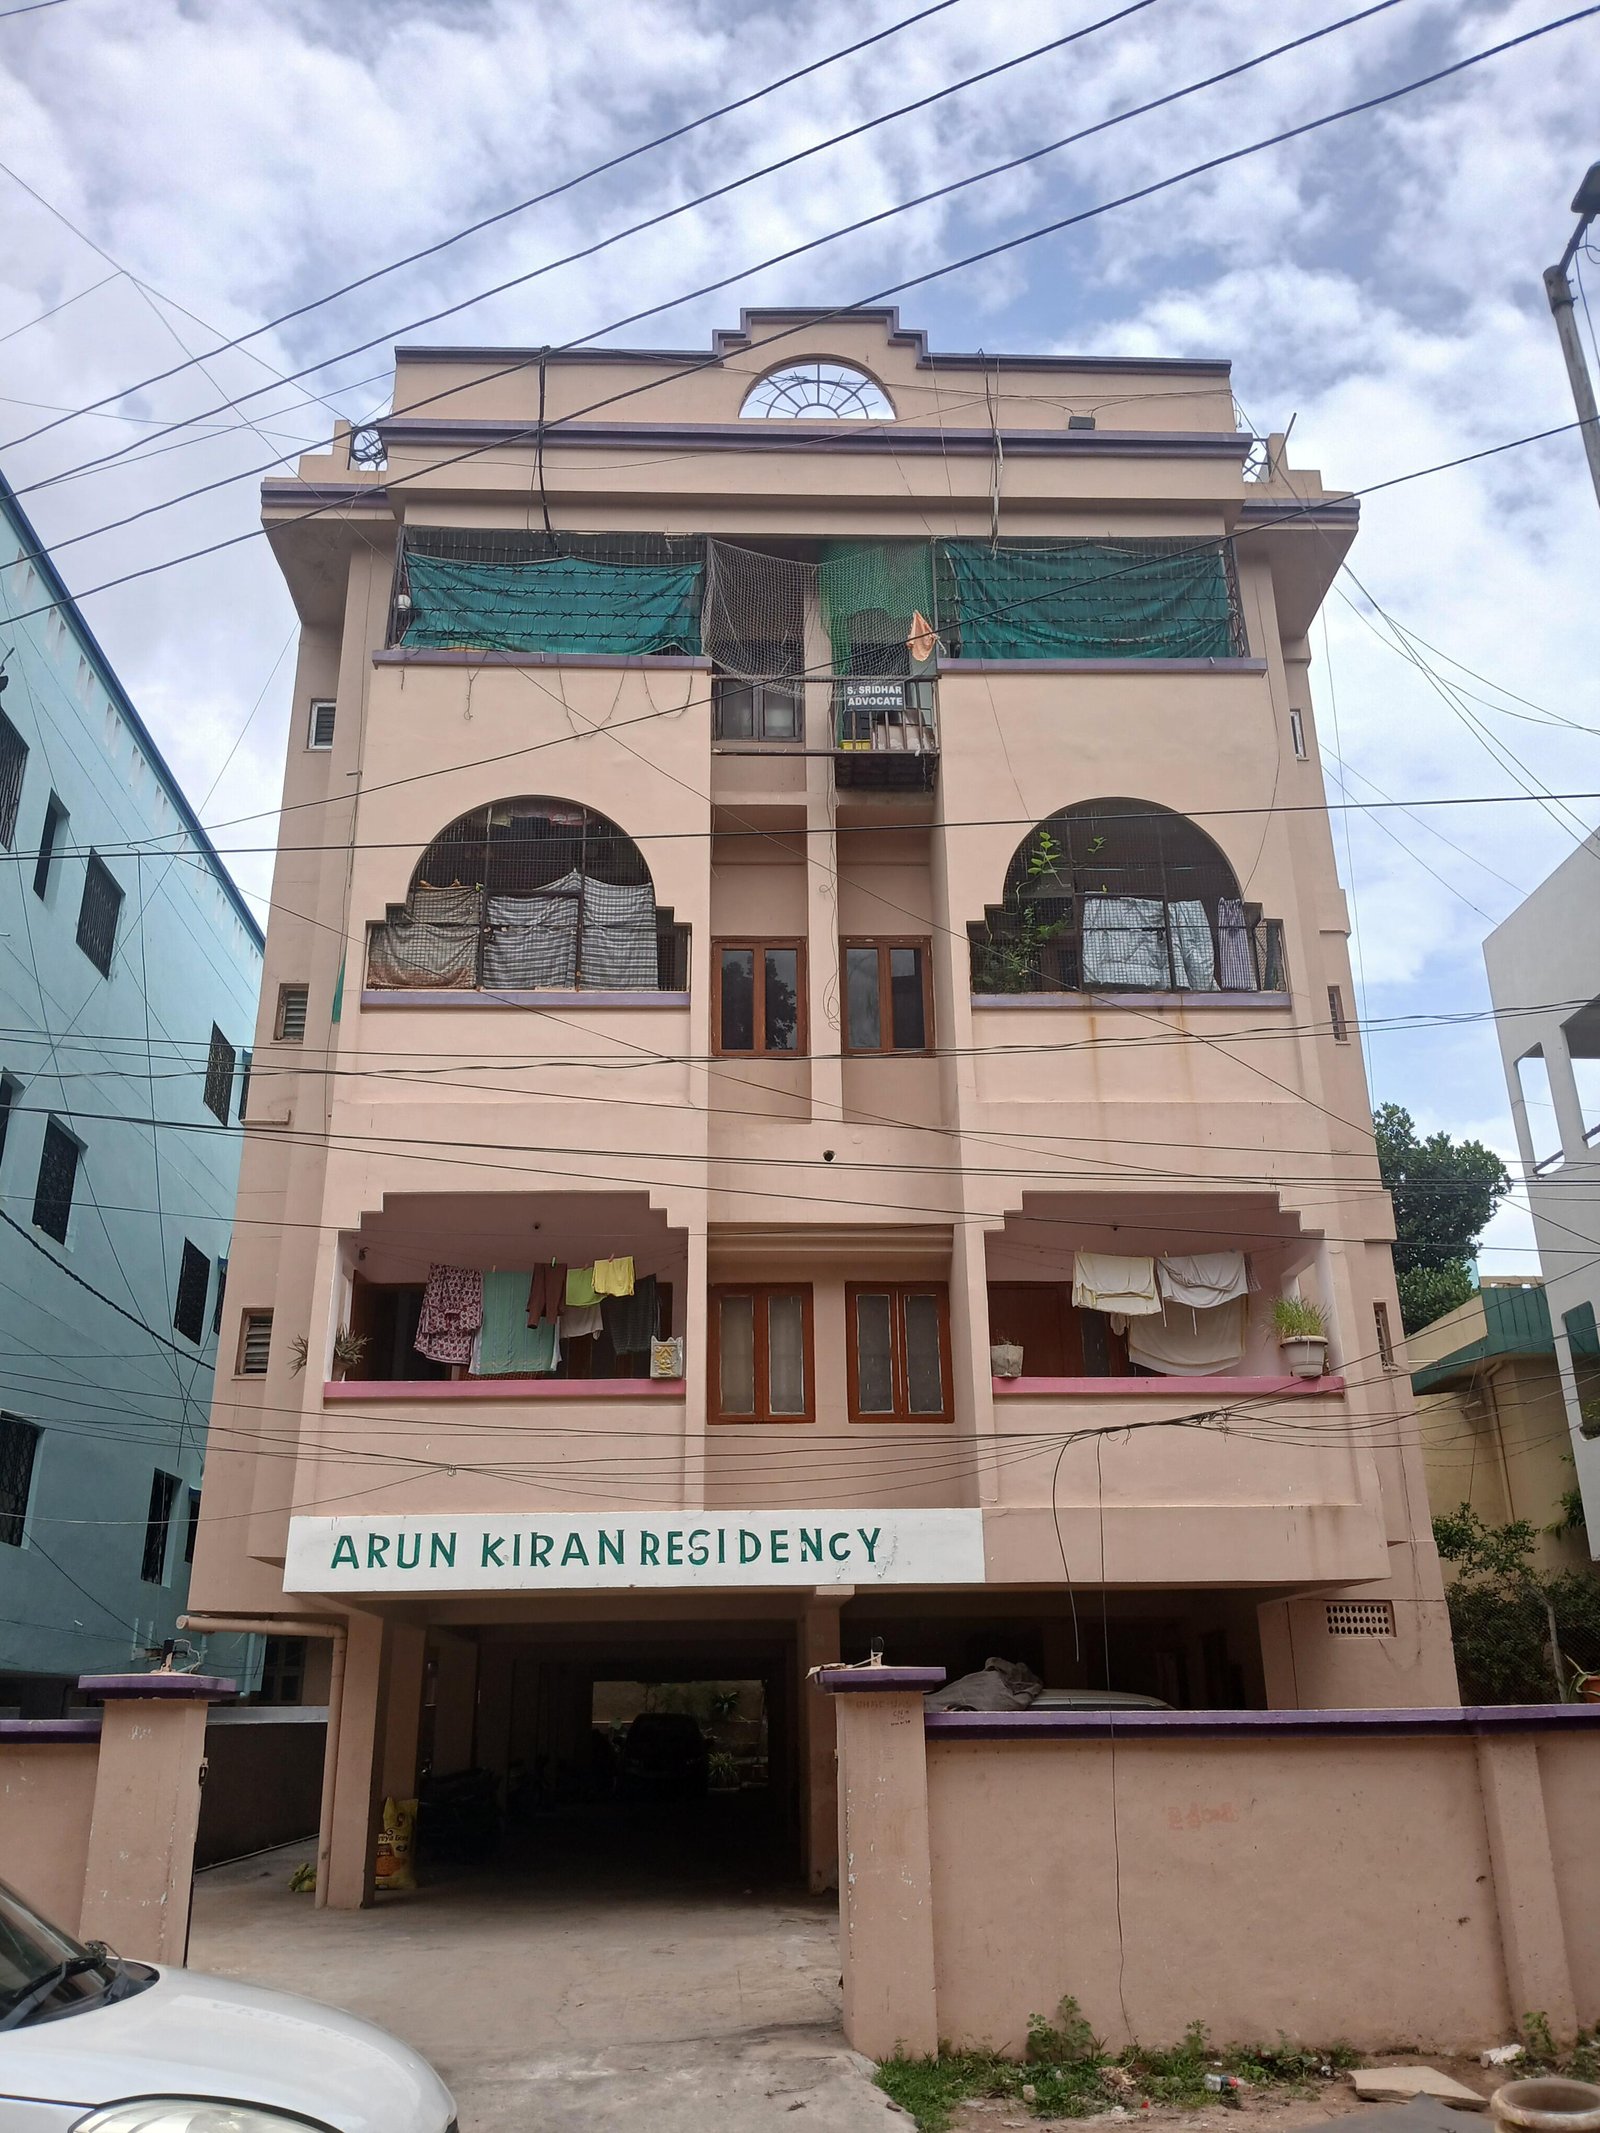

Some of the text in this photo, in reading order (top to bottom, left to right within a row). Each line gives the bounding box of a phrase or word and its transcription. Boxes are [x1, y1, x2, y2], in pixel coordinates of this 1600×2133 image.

[847, 685, 902, 695] S. SRIDHAR
[847, 697, 903, 706] ADVOCATE
[330, 1527, 882, 1570] ARUN KIRAN RESIDENCY
